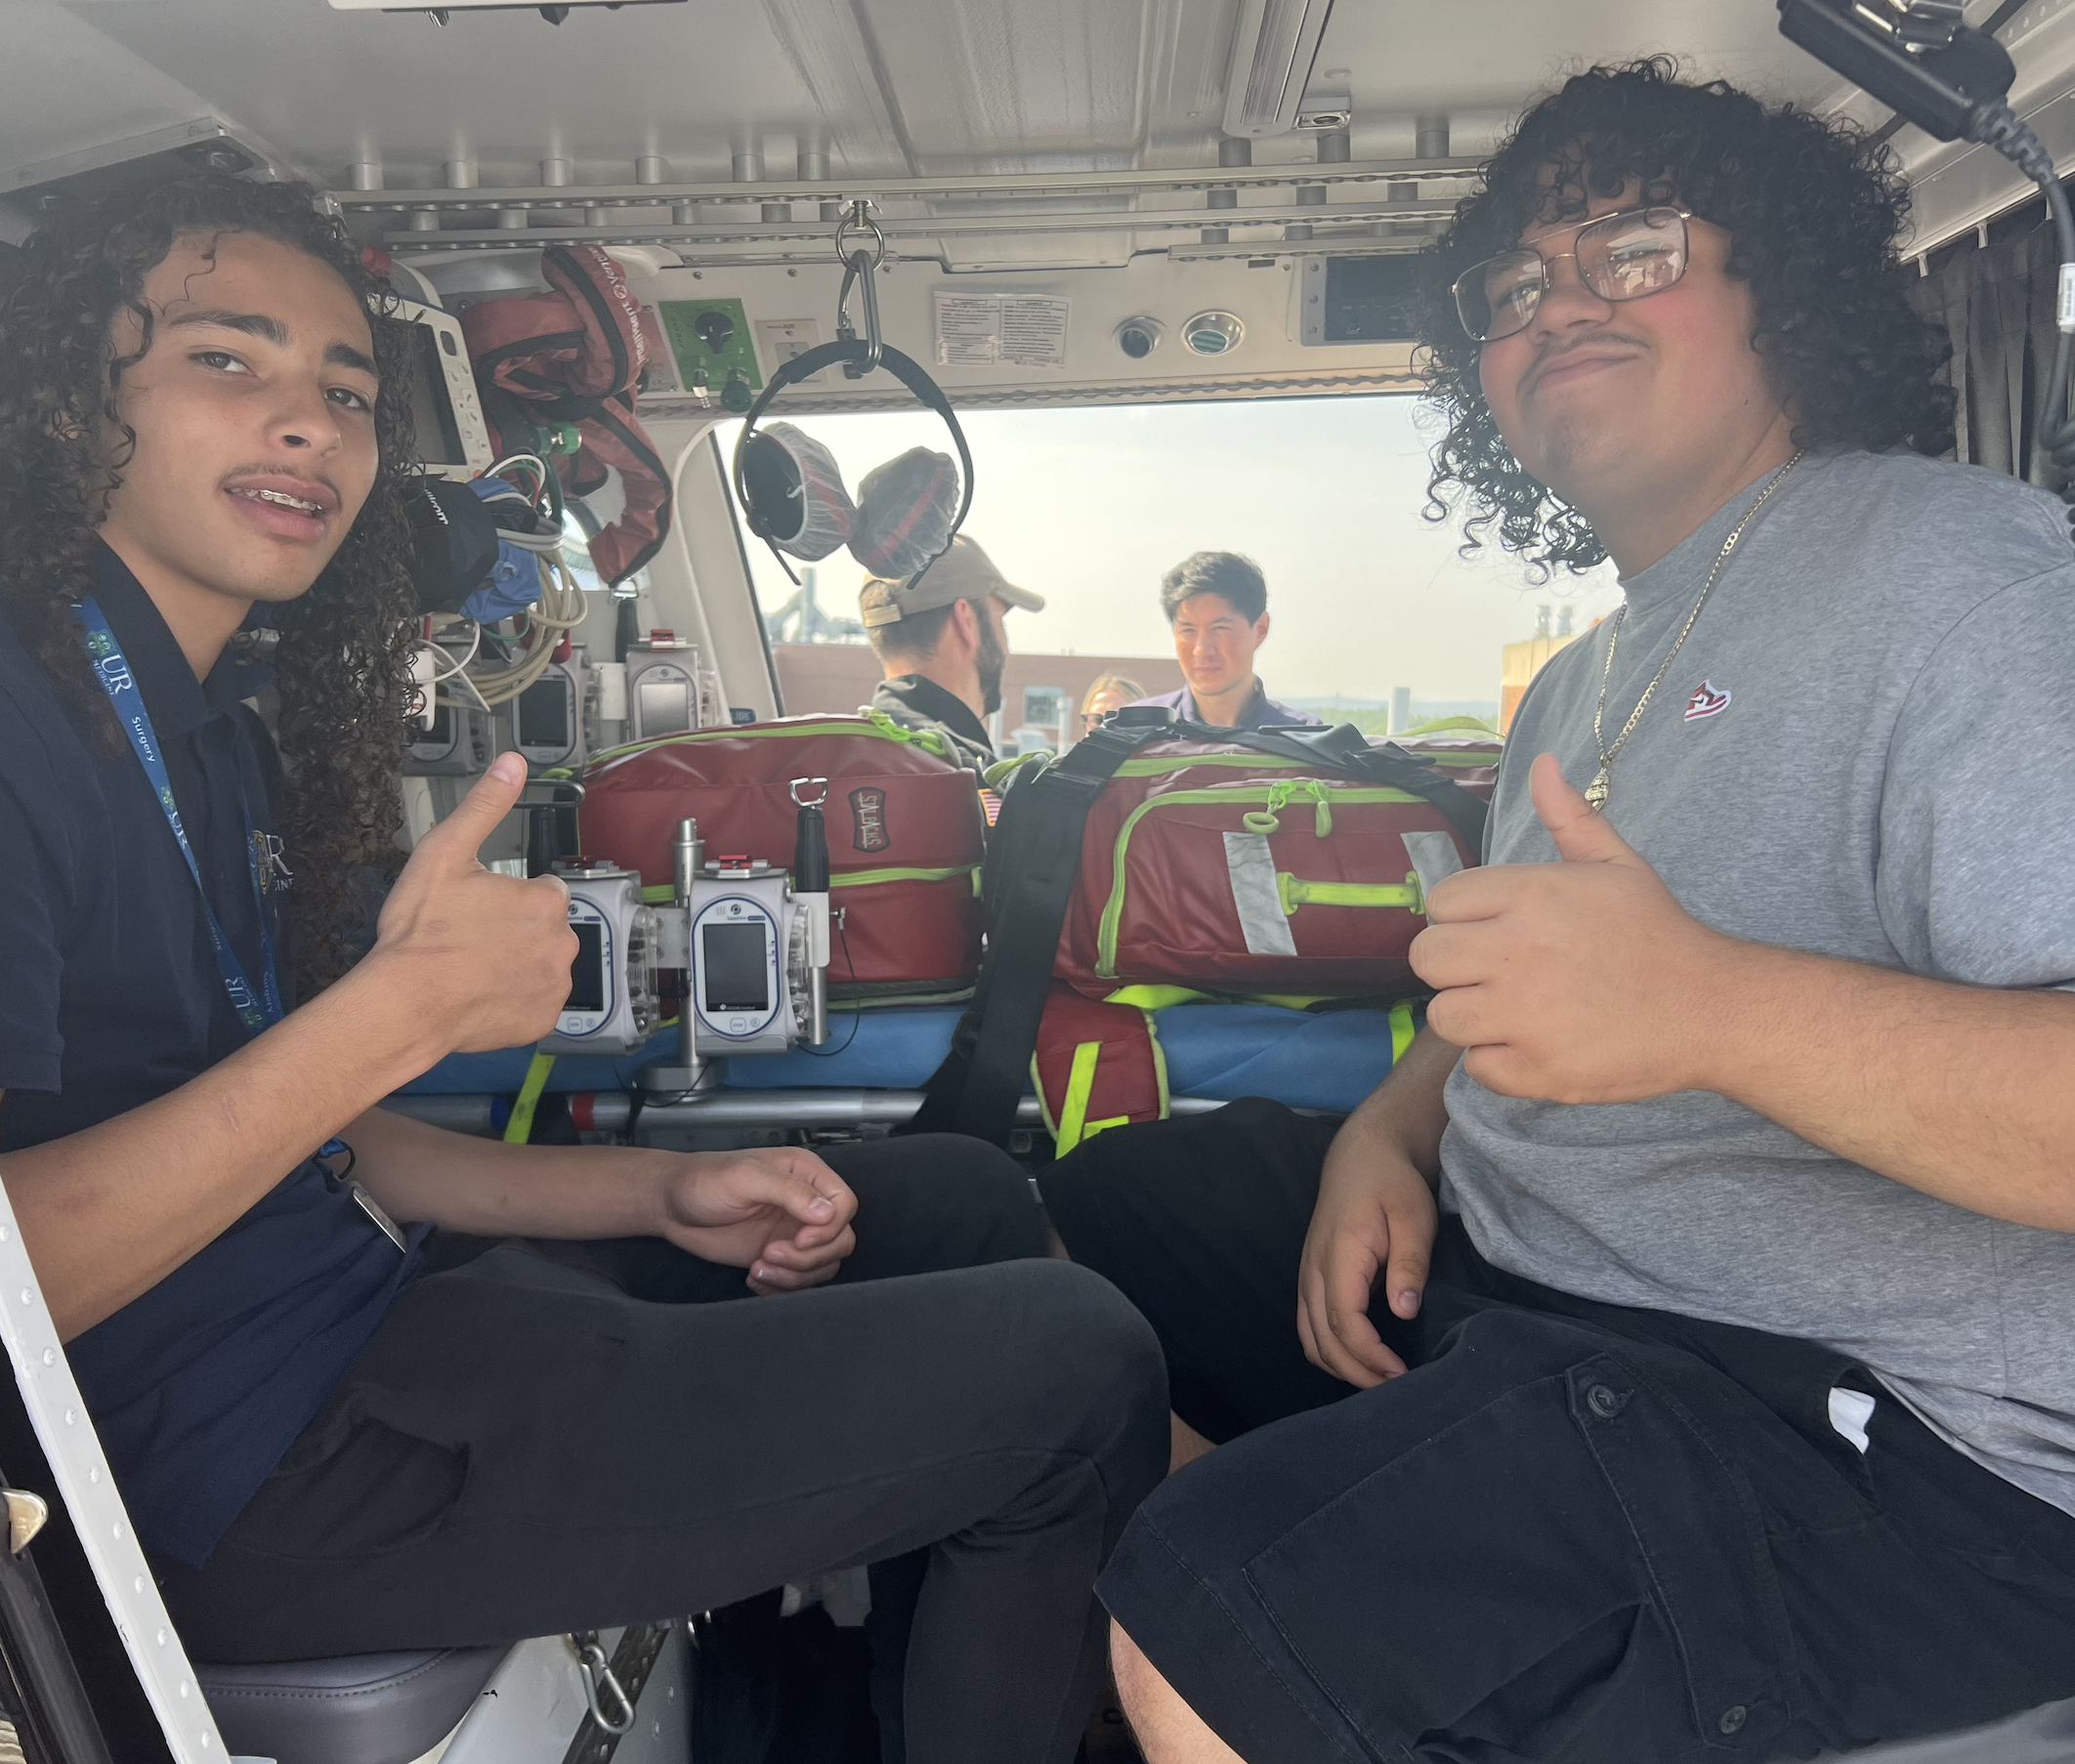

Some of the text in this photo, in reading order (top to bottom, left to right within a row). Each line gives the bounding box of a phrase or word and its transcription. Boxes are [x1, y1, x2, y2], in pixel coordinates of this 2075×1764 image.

[424, 489, 448, 525] illrom
[101, 653, 133, 695] UR
[132, 716, 155, 762] Surgery
[225, 977, 251, 1009] UR
